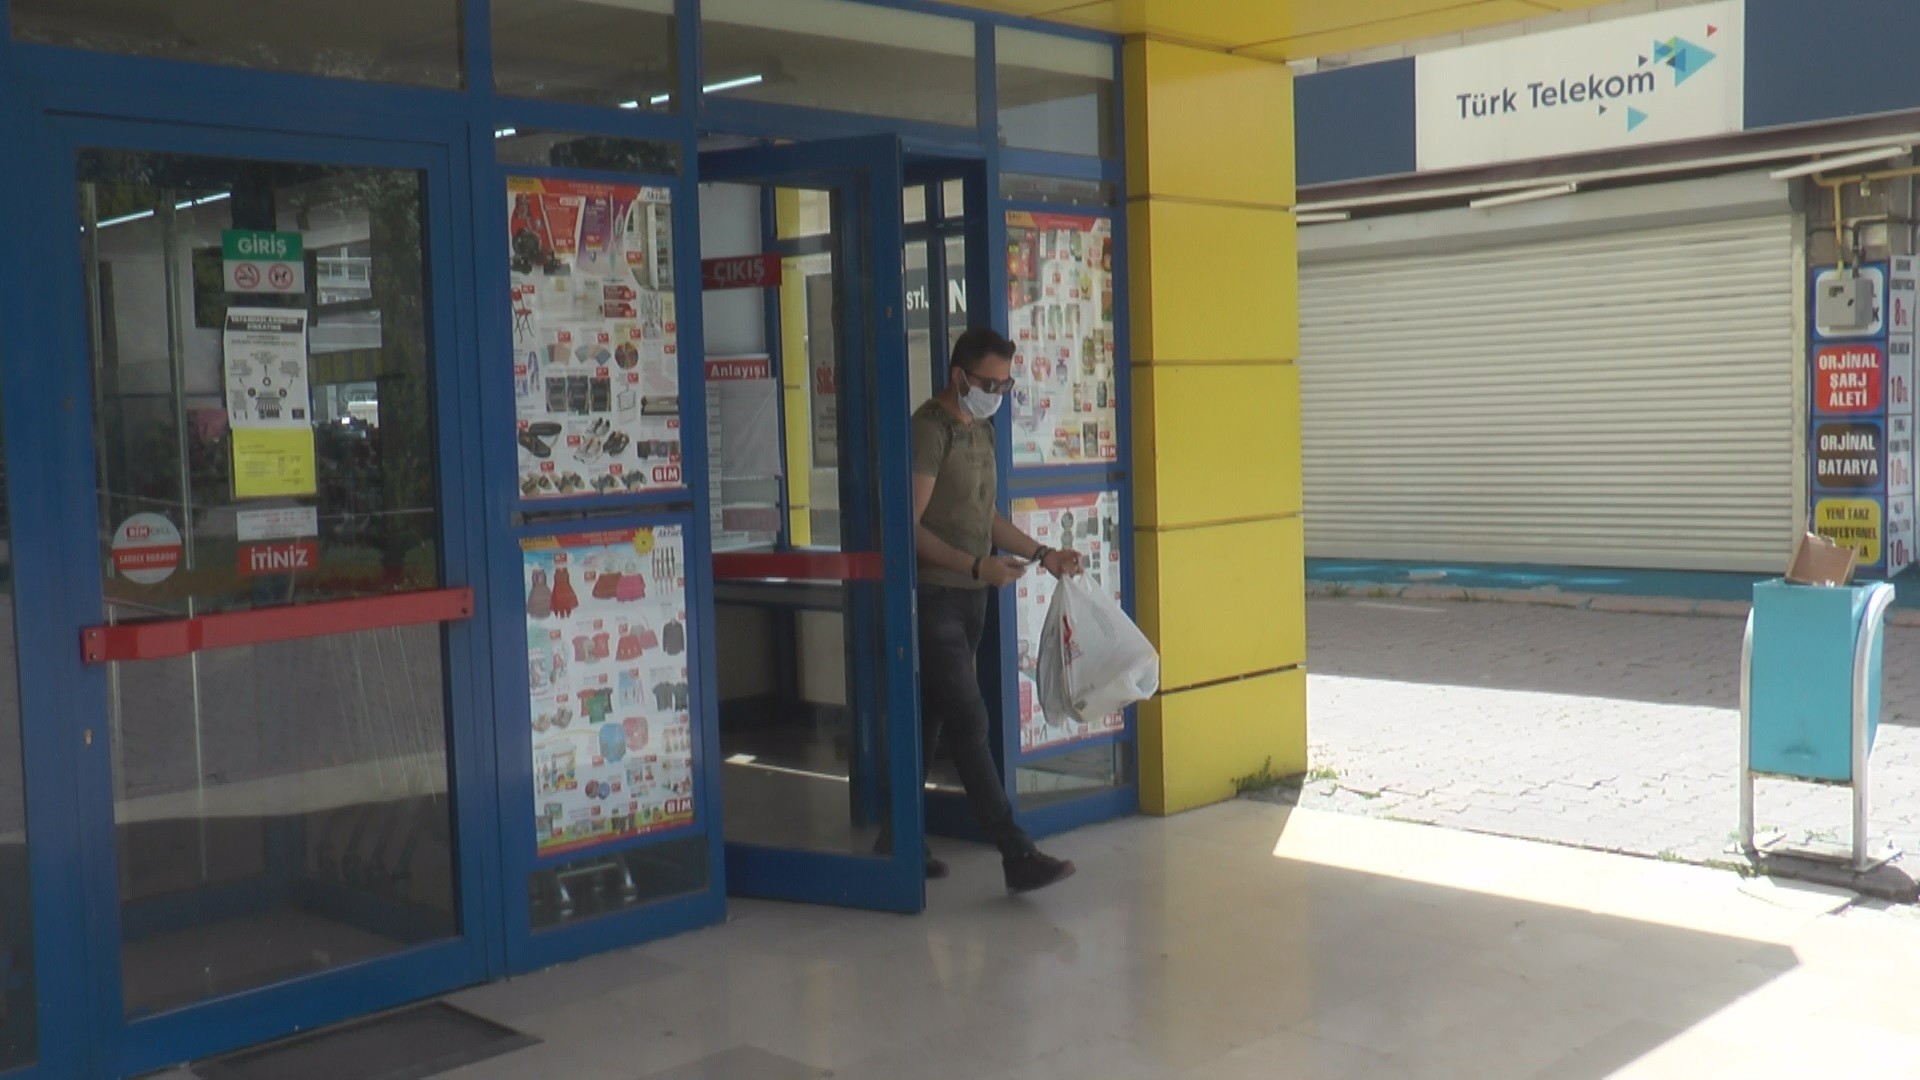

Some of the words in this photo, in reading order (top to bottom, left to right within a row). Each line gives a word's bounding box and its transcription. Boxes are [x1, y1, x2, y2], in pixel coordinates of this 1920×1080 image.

[1457, 87, 1517, 119] Türk
[1527, 70, 1655, 109] Telekom
[237, 233, 287, 259] GİRİŞ
[713, 259, 765, 286] ÇIKIŞ
[1818, 351, 1879, 370] ORJİNAL
[710, 364, 766, 379] Anlayışı
[1829, 373, 1867, 389] ŞARJ
[1829, 389, 1867, 406] ALETİ
[1820, 432, 1876, 451] ORJİNAL
[1818, 459, 1878, 475] BATARYA
[250, 545, 308, 571] İTİNİZ
